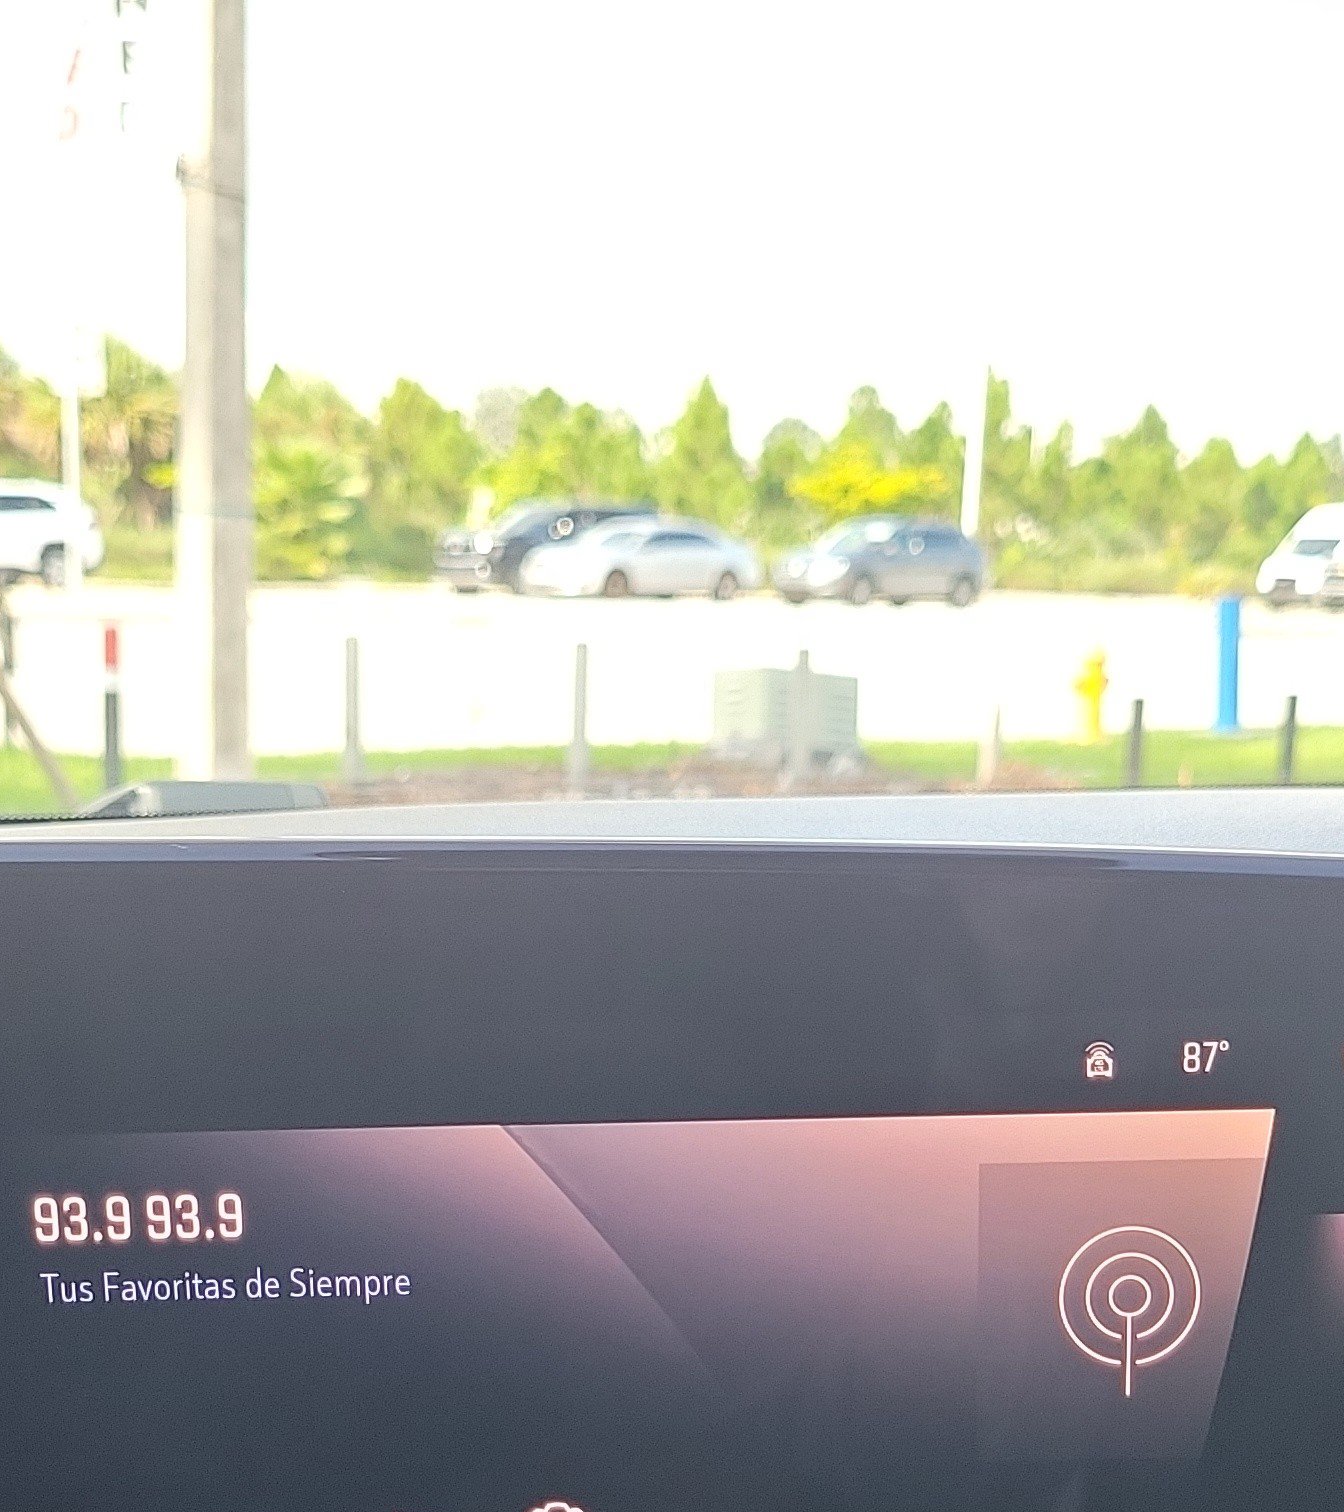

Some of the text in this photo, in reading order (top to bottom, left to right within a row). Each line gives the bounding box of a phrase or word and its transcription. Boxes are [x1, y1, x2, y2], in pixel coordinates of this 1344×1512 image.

[1182, 1038, 1231, 1074] 87°
[33, 1192, 243, 1243] 93.9 93.9
[39, 1266, 412, 1306] Tus Favoritas de Siempre
